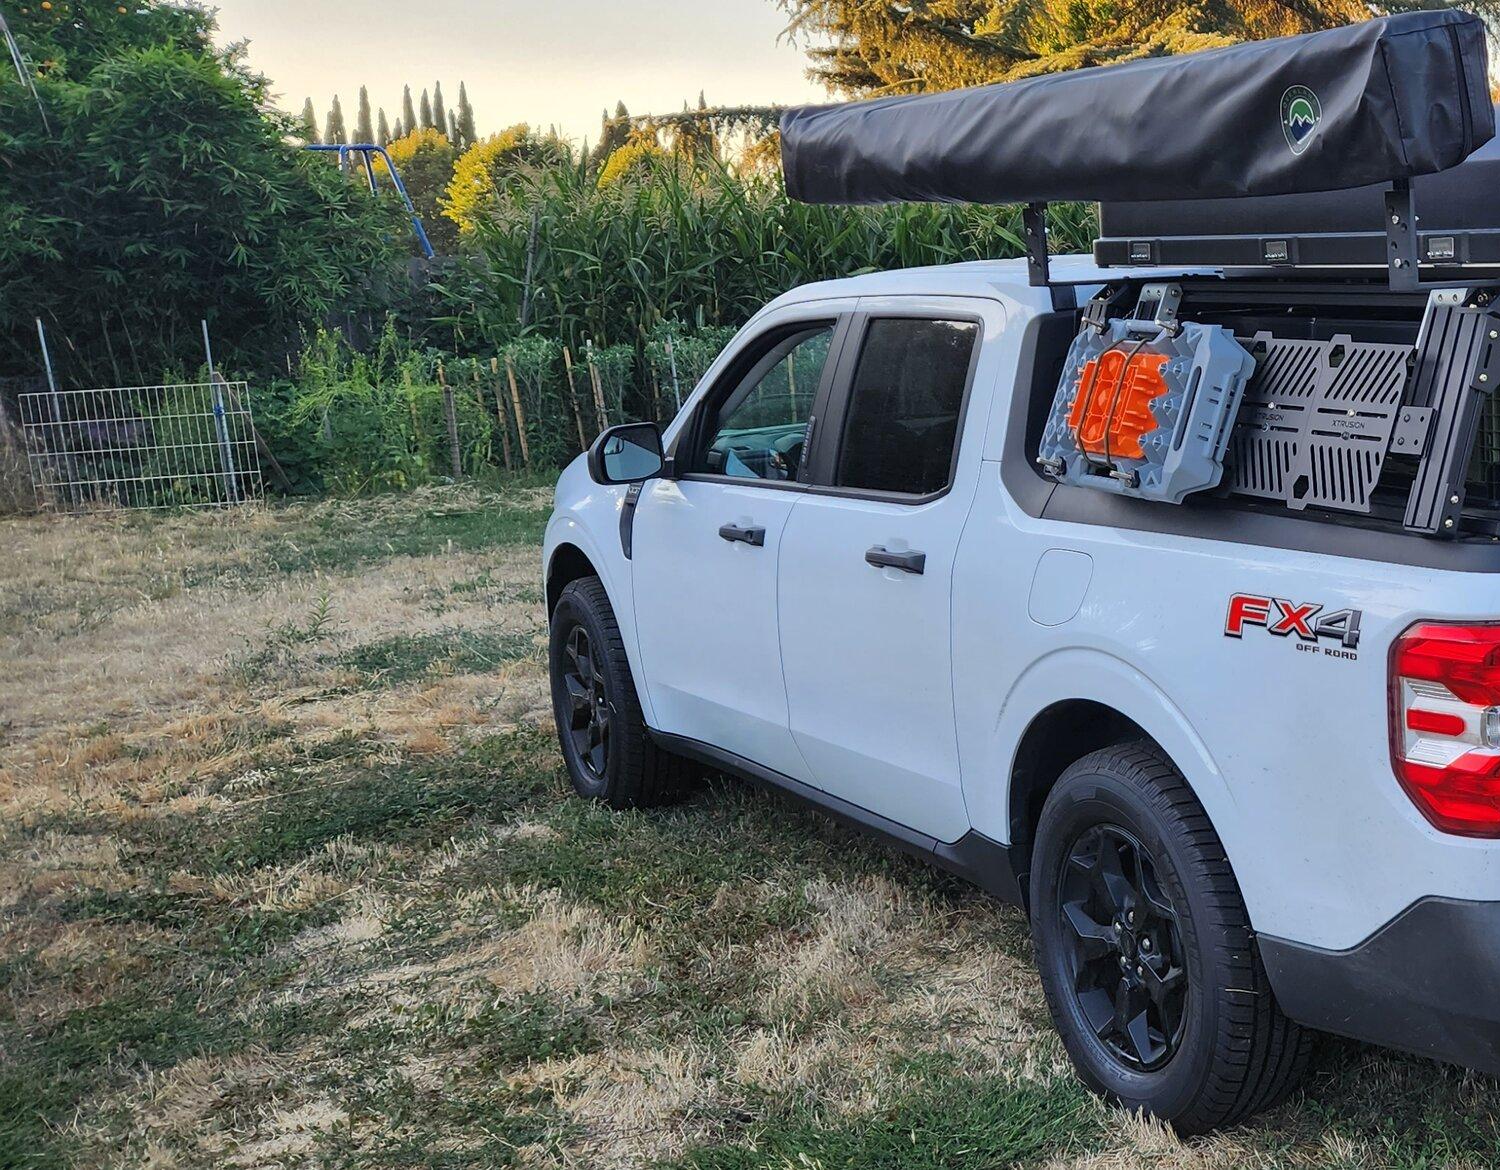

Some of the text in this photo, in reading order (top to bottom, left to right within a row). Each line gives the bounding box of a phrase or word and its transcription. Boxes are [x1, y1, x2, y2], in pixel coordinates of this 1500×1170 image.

[1332, 419, 1366, 429] XTRUSION
[1224, 592, 1362, 650] FX4
[1296, 643, 1358, 661] OFF ROAD
